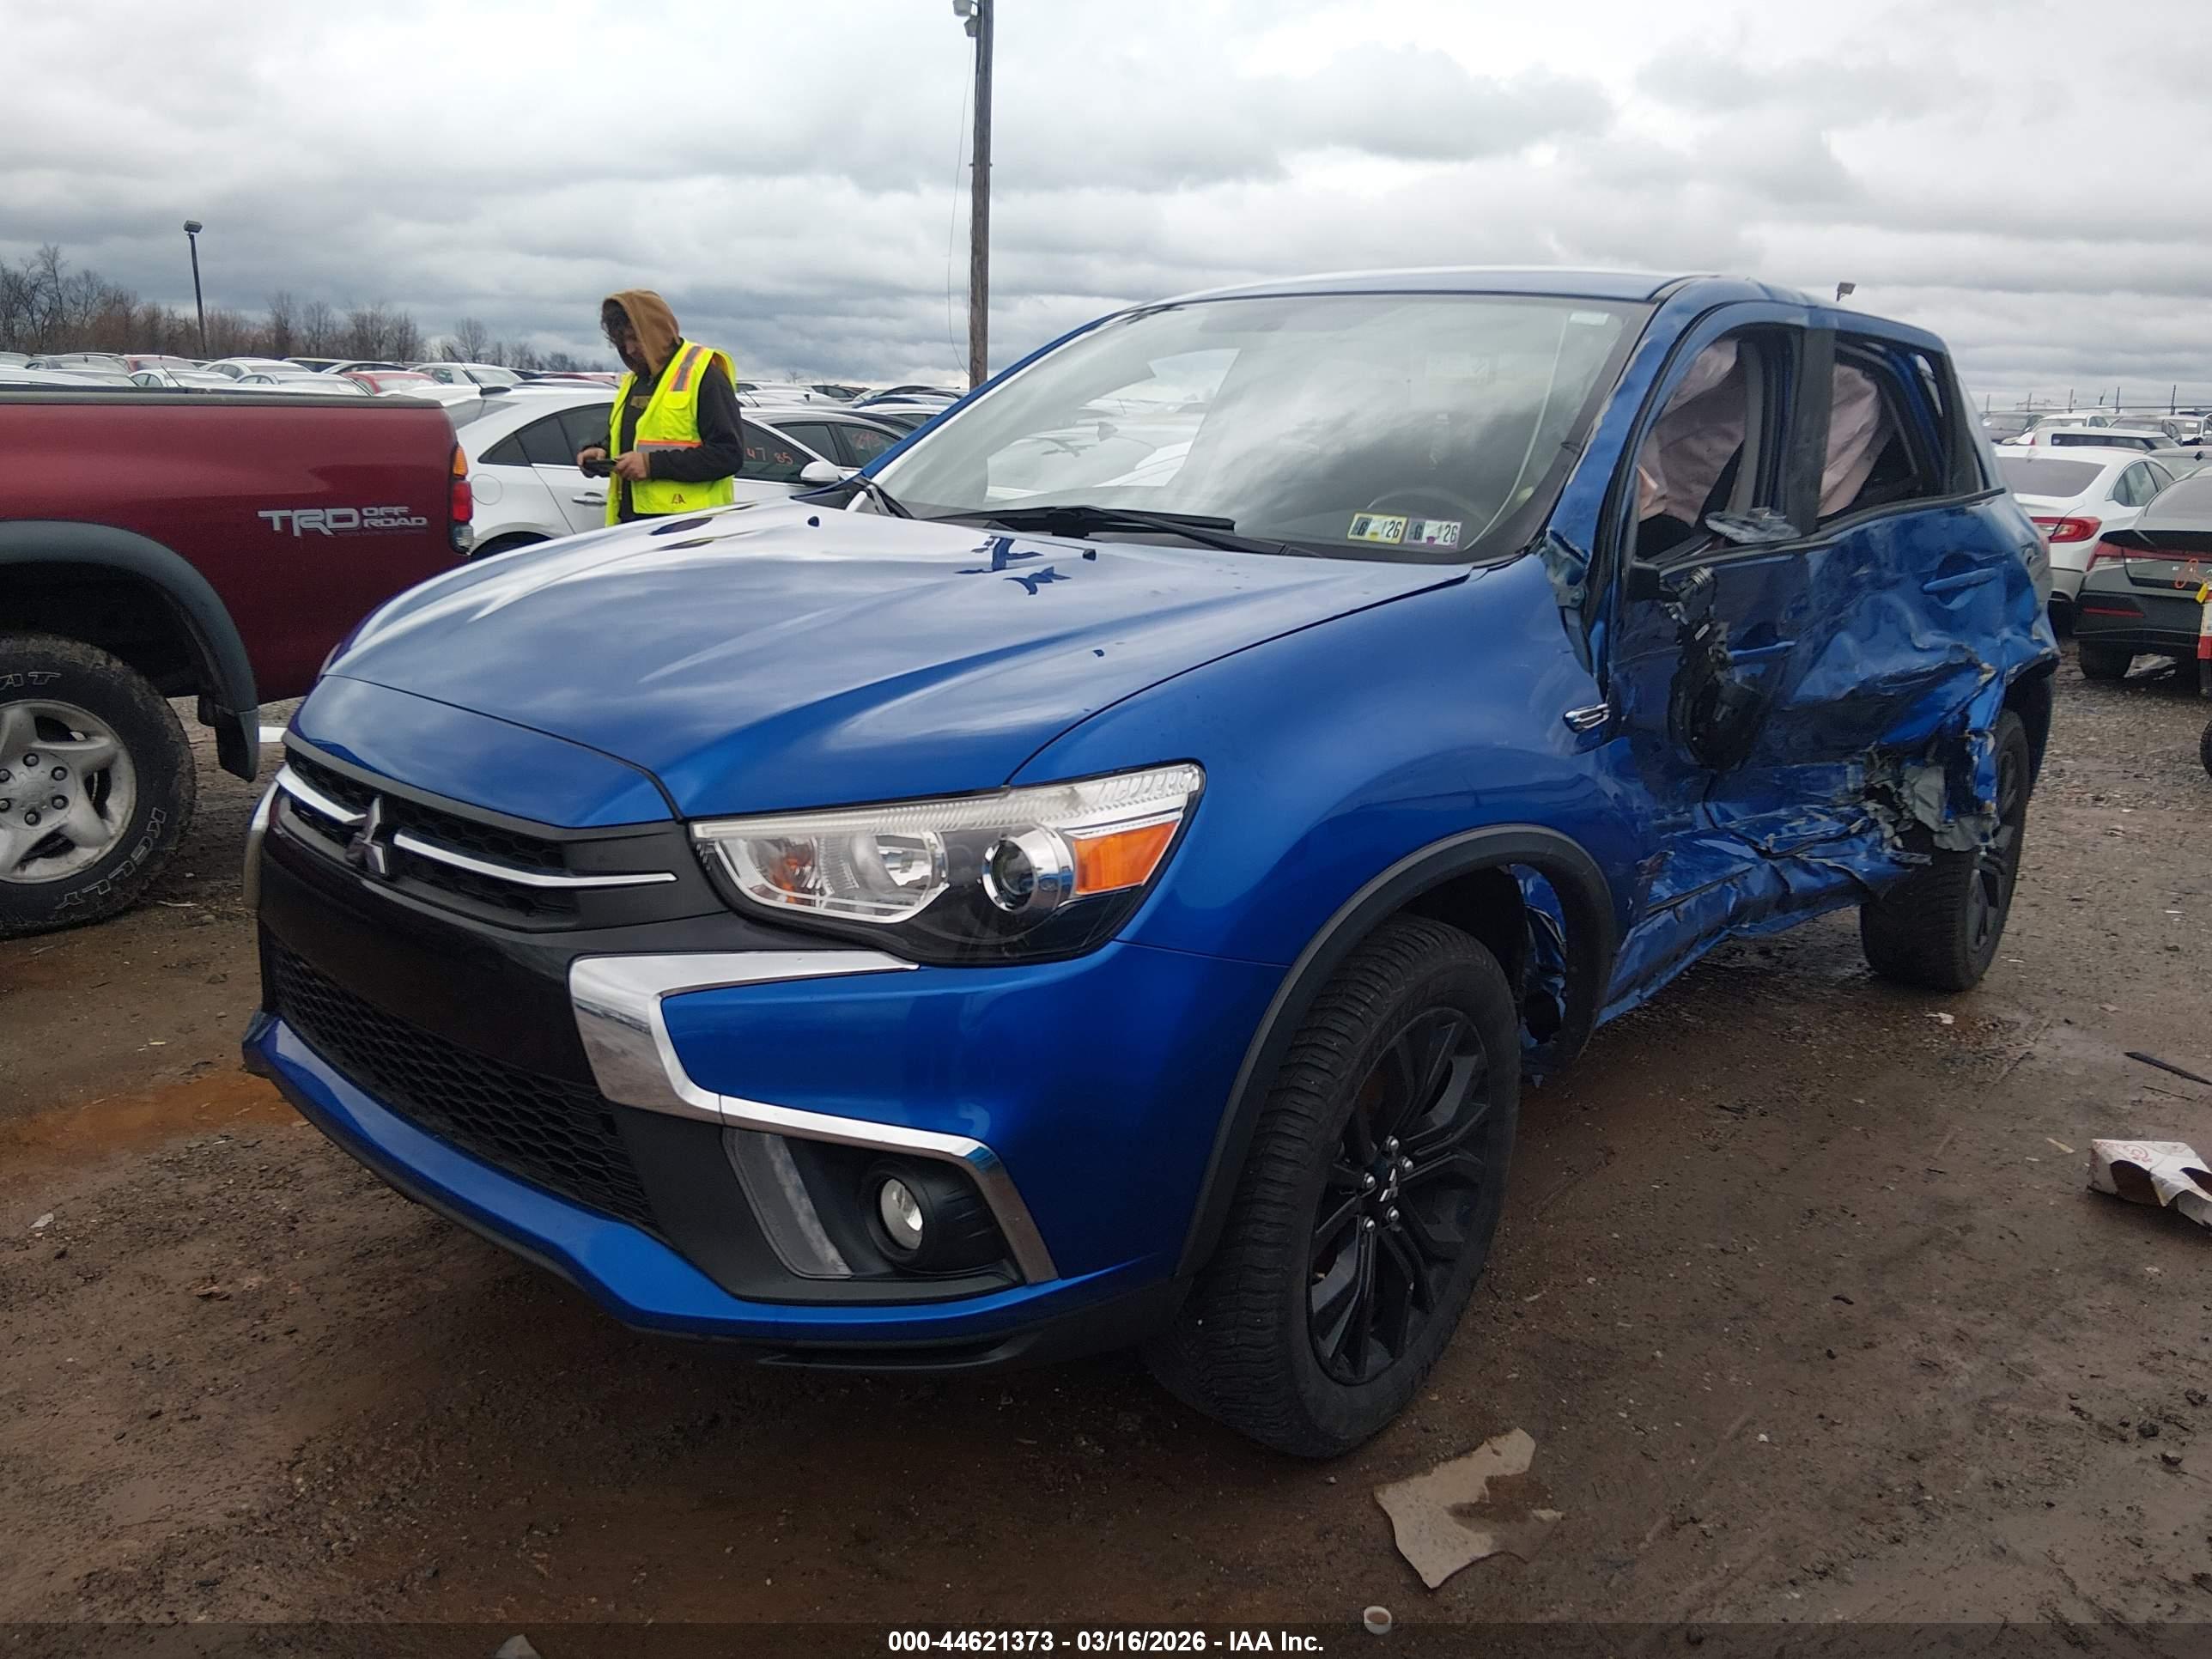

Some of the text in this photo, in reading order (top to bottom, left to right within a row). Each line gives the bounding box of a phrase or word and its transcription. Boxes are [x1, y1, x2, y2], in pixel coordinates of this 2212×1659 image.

[362, 506, 410, 517] OFF
[258, 507, 361, 537] TRD
[363, 517, 428, 528] ROAD
